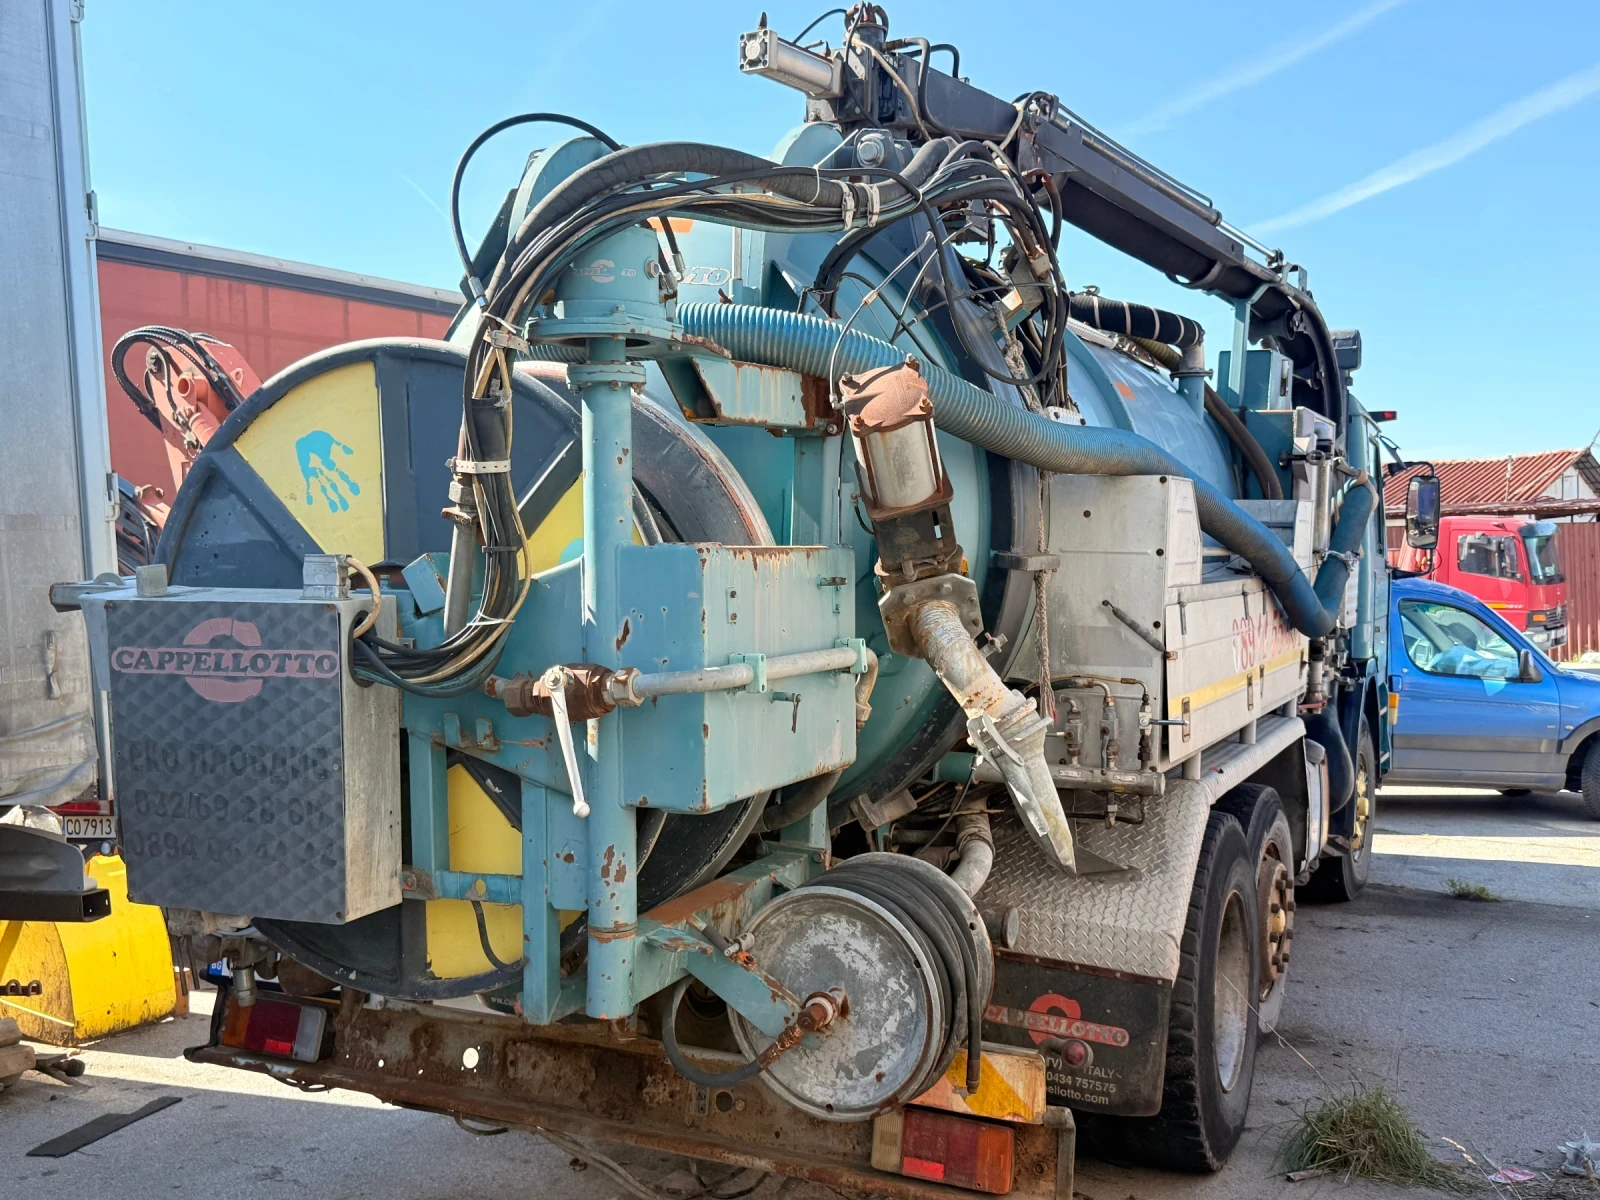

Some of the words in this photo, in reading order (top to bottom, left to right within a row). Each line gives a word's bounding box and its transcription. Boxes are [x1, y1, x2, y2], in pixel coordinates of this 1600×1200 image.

[116, 650, 338, 676] CAPPELLOTTO
[211, 961, 222, 970] BG
[985, 1005, 1128, 1045] CAPPELLOTTO
[1046, 1071, 1073, 1085] 0434
[1075, 1077, 1117, 1093] 757575
[1046, 1085, 1110, 1105] ellotto.com
